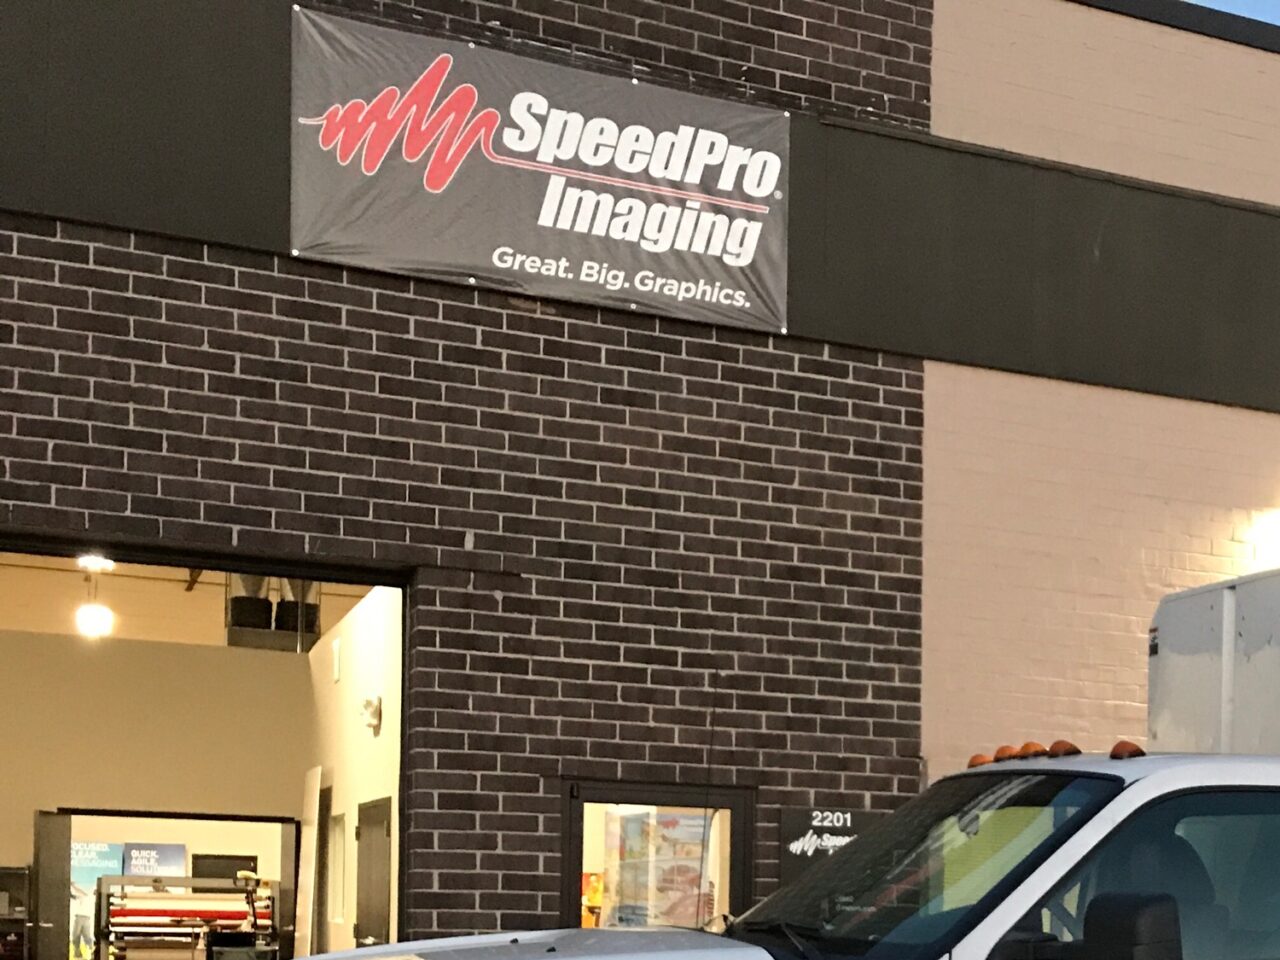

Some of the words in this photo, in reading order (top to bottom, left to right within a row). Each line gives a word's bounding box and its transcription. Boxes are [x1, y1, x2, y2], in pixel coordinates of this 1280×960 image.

[502, 92, 782, 199] SpeedPro
[537, 175, 763, 267] Imaging
[491, 247, 574, 280] Great.
[580, 260, 631, 290] Big.
[634, 271, 751, 307] Graphics.
[811, 810, 851, 827] 2201
[71, 842, 110, 852] OCUSED.
[130, 849, 159, 858] QUICK.
